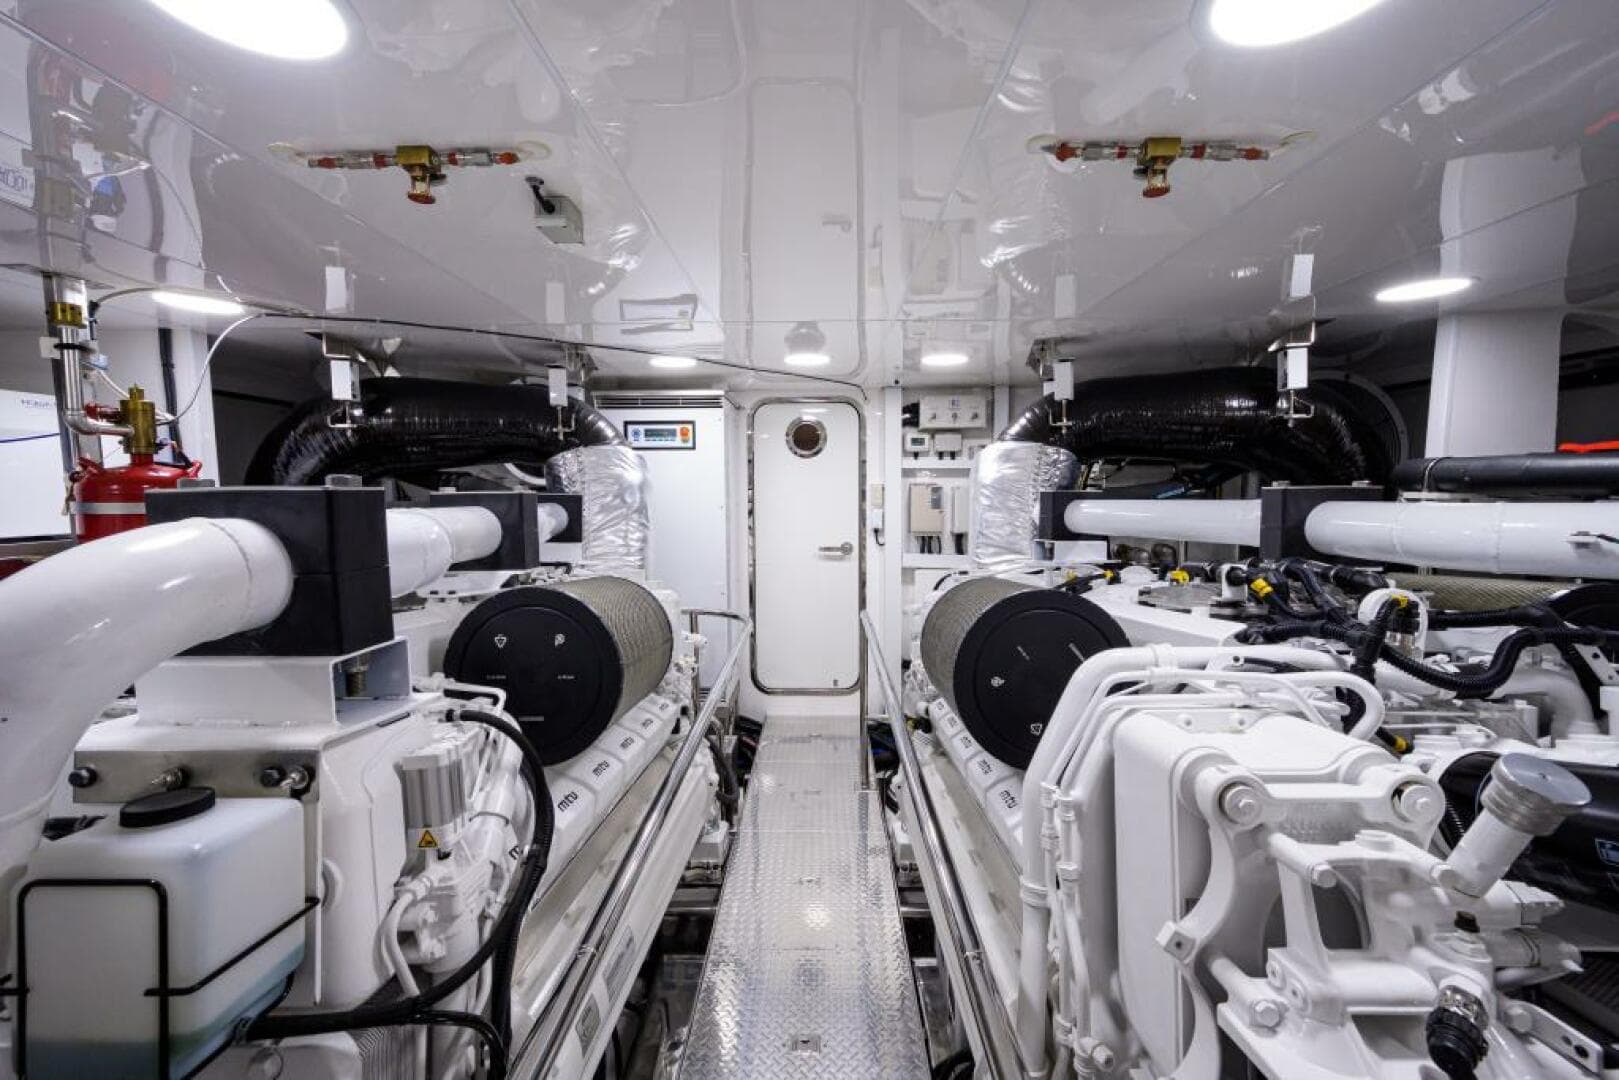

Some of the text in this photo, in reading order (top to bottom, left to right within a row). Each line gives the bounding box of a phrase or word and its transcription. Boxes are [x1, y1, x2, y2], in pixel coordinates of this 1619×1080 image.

[592, 760, 610, 777] mtu
[557, 791, 579, 812] mtu
[999, 790, 1018, 808] mtu
